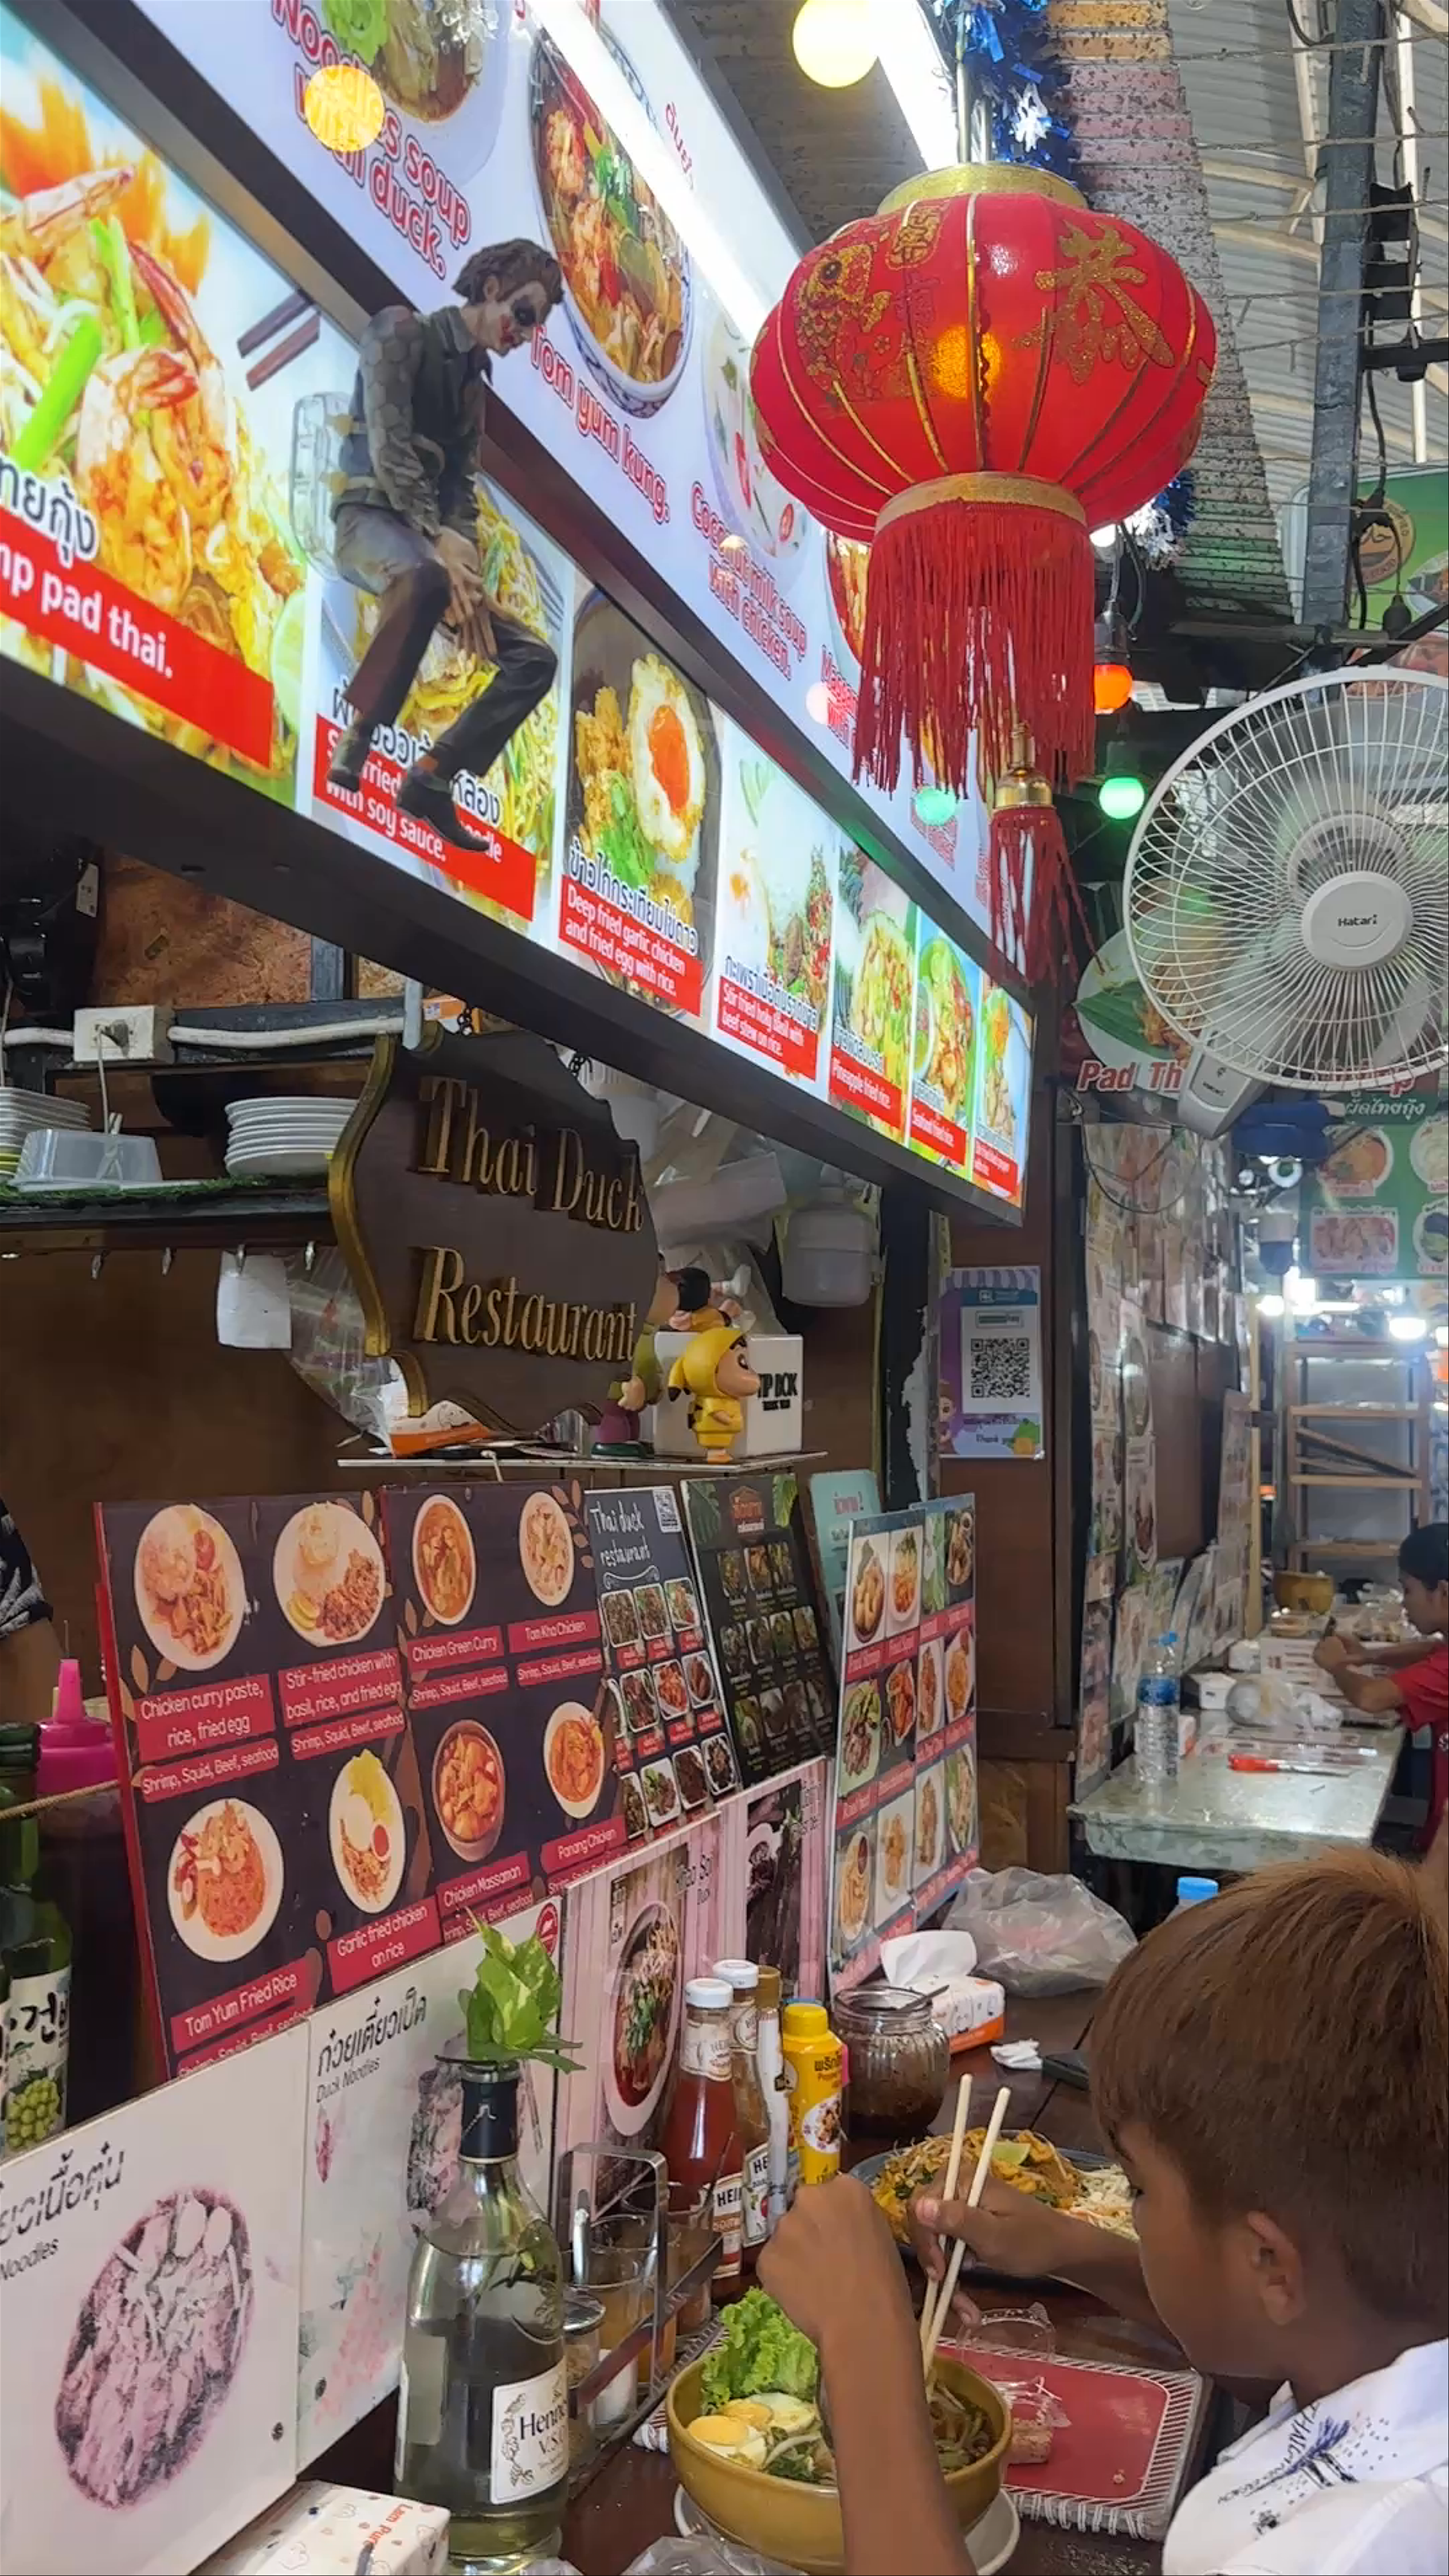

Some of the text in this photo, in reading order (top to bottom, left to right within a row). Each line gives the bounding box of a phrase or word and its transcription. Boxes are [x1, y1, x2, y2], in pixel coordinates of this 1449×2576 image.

[403, 135, 471, 249] soup
[531, 324, 574, 409] Tom
[576, 378, 619, 464] yum
[42, 571, 102, 634] pad
[108, 605, 173, 679] thai.
[367, 796, 397, 837] soy
[400, 817, 446, 863] sauce.
[567, 883, 686, 976] Deep fried garlic chicken
[1338, 915, 1378, 927] Hatari
[565, 917, 588, 945] and
[589, 928, 614, 959] fried
[615, 947, 635, 977] egg
[635, 955, 657, 985] with
[1077, 1061, 1185, 1092] Pad Th
[417, 1077, 644, 1232] Thai Duck
[416, 1246, 637, 1362] Restaurant
[589, 1499, 645, 1534] Thai duck
[600, 1535, 651, 1567] restaurant
[413, 1636, 499, 1662] Chicken Green Curry
[557, 1620, 586, 1637] Chicken
[285, 1653, 396, 1690] Stir-fried chicken with
[140, 1680, 265, 1721] Chicken curry paste,
[286, 1680, 403, 1721] basil, rice, and fried egg
[167, 1715, 251, 1750] rice, fried egg
[142, 1744, 279, 1795] Shrimp, Squid, Beef, seafood
[588, 1828, 617, 1848] Chicken
[444, 1885, 478, 1907] Chicken
[477, 1865, 521, 1896] Massaman
[337, 1904, 428, 1956] Garlic fried chicken
[371, 1941, 405, 1968] on rice
[185, 1973, 297, 2038] Tom Yum Fried Rice
[316, 2077, 340, 2103] Duck
